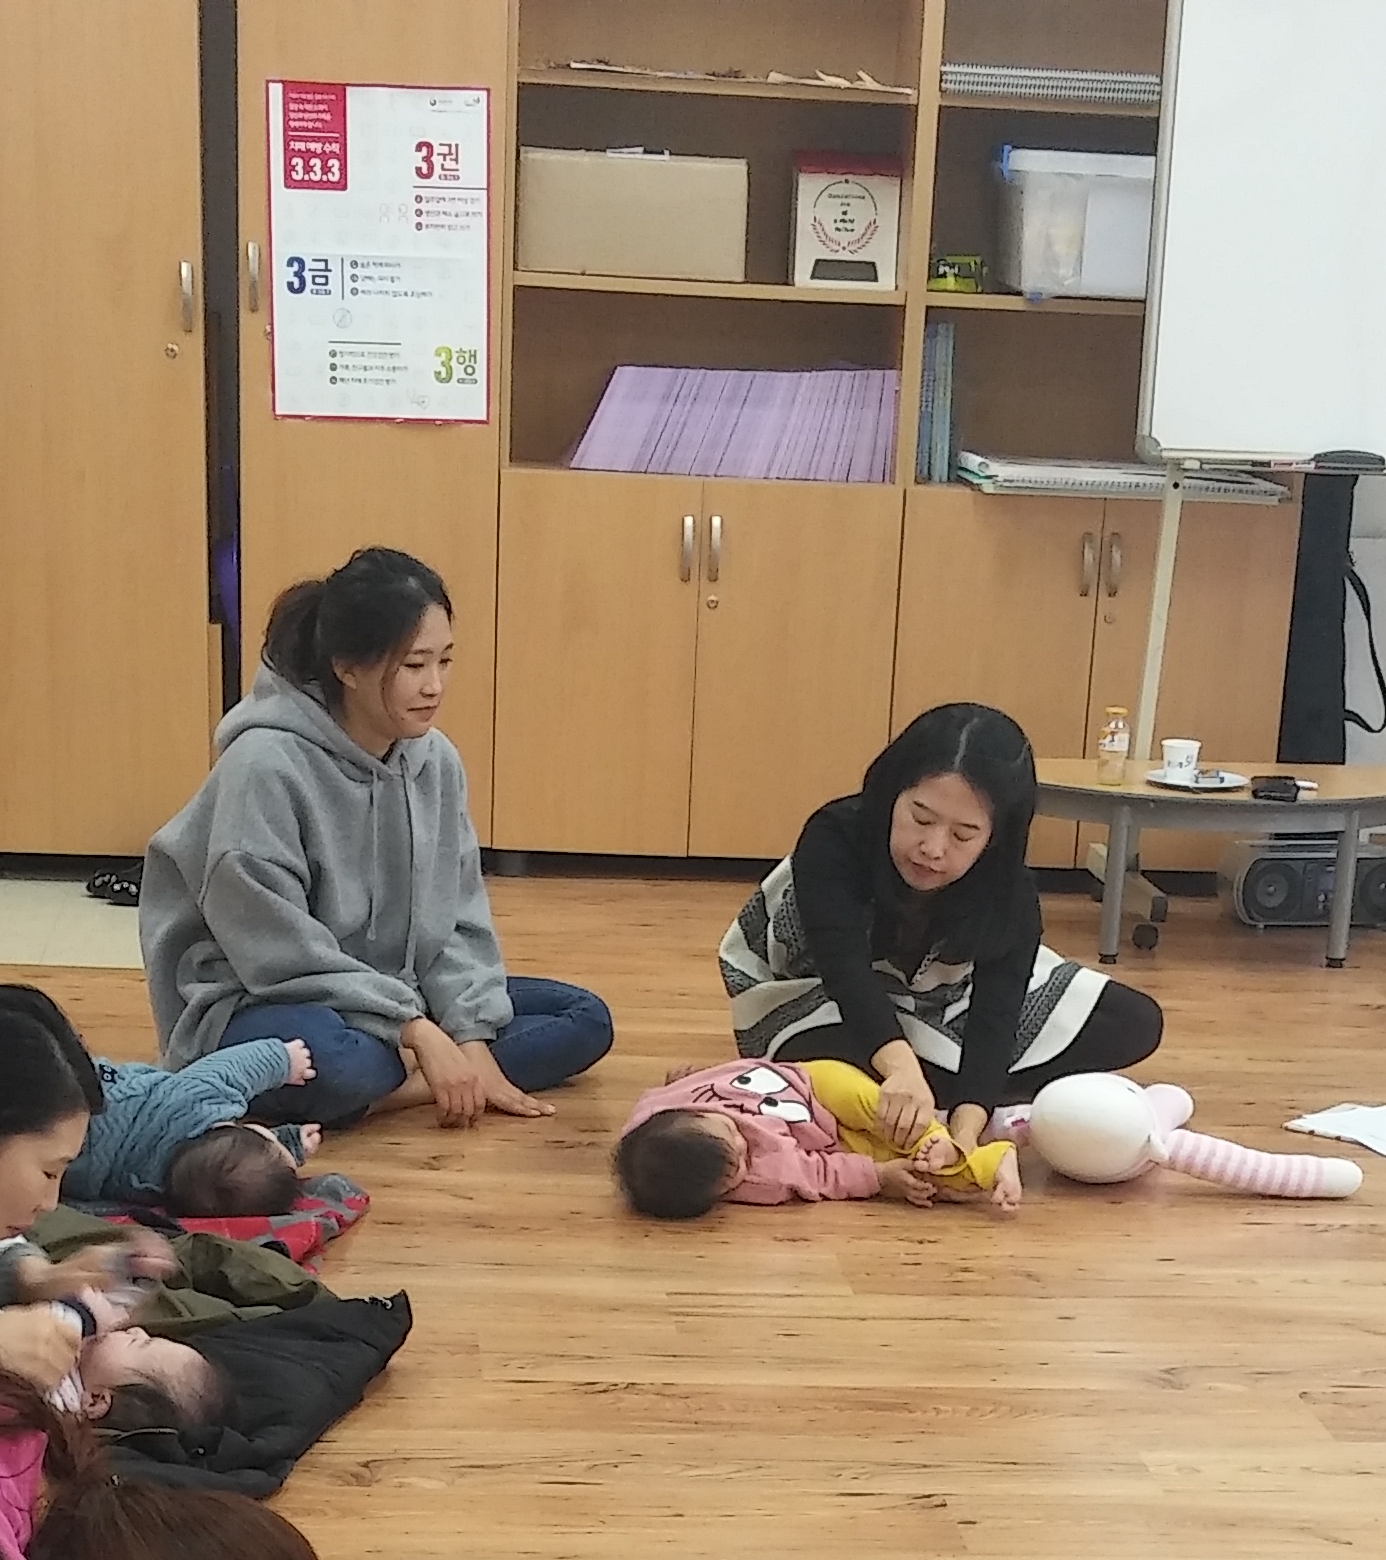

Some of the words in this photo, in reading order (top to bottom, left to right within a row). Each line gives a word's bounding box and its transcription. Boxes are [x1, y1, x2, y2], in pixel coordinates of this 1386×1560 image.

[290, 156, 340, 182] 3.3.3
[414, 141, 460, 180] 3권
[286, 256, 332, 295] 3금
[434, 346, 478, 384] 3행
